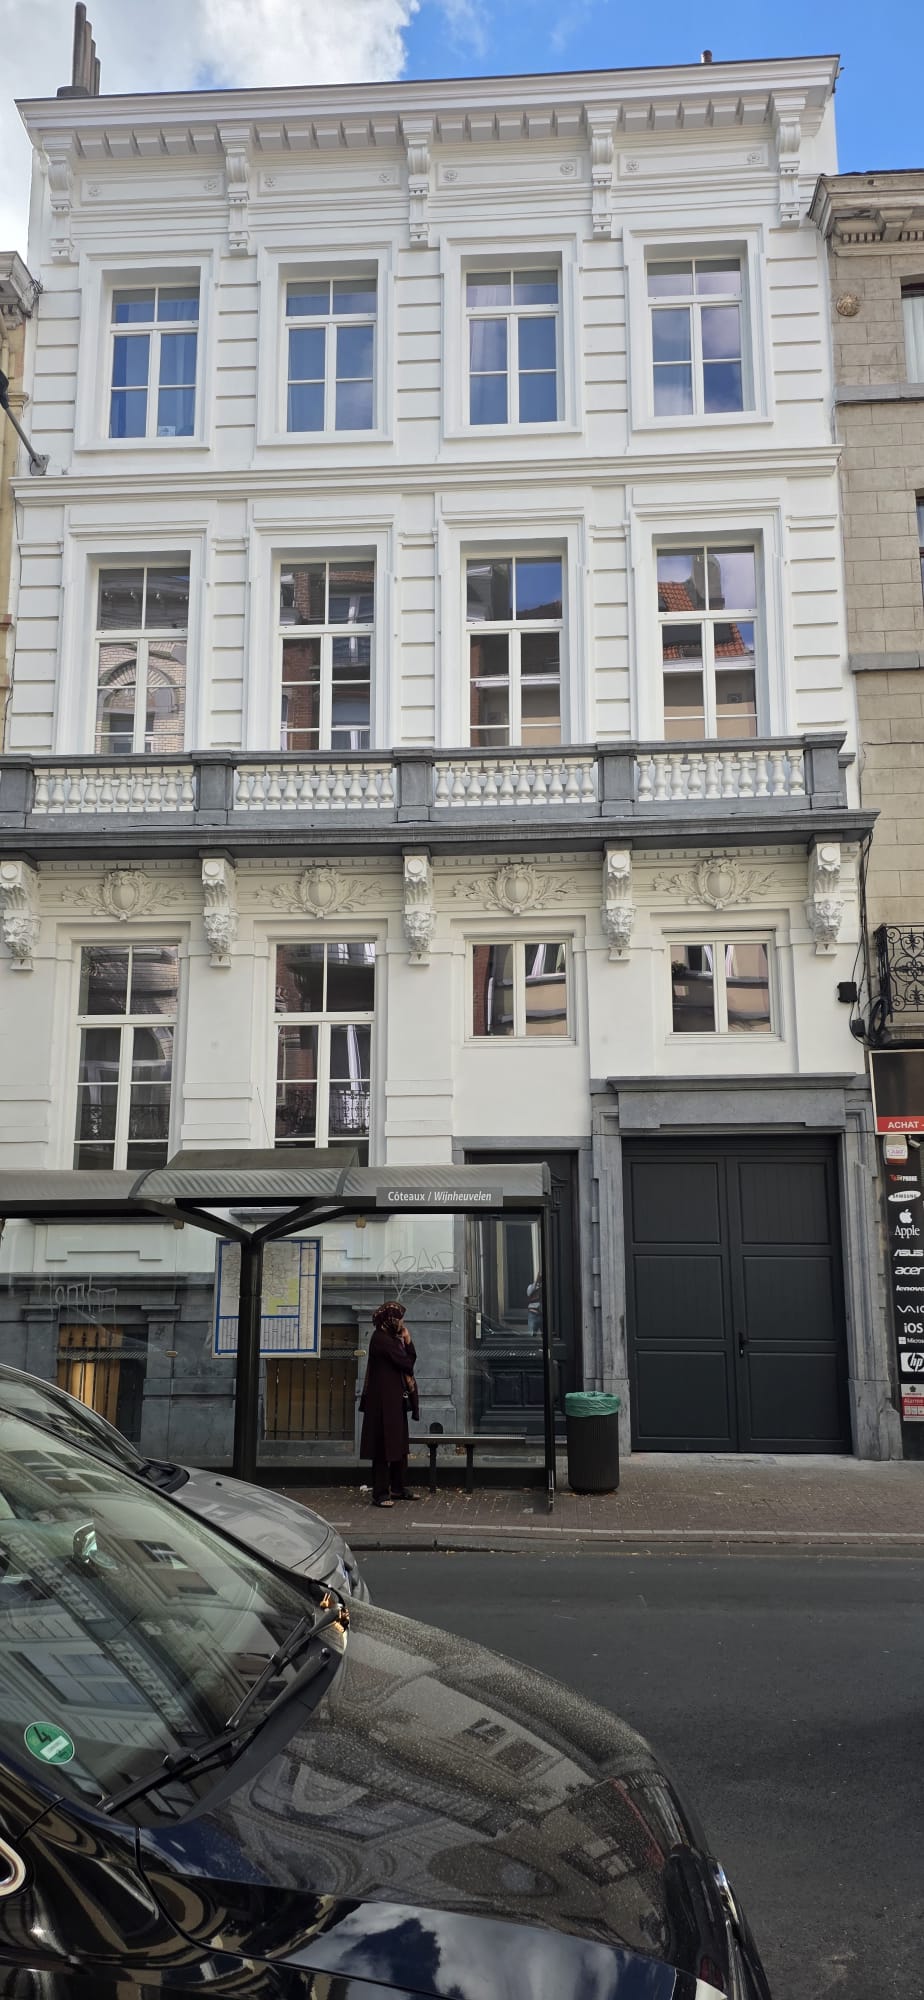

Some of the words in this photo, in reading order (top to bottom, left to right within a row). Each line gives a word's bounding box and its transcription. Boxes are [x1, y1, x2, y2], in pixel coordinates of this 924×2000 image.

[888, 1121, 919, 1129] ACHAT
[388, 1191, 425, 1201] Côteaux
[434, 1191, 492, 1204] Wijnheuvelen
[895, 1224, 921, 1239] Apple
[894, 1249, 923, 1257] ASUS
[895, 1266, 924, 1275] acer
[904, 1322, 923, 1334] iOS
[910, 1352, 923, 1373] hp
